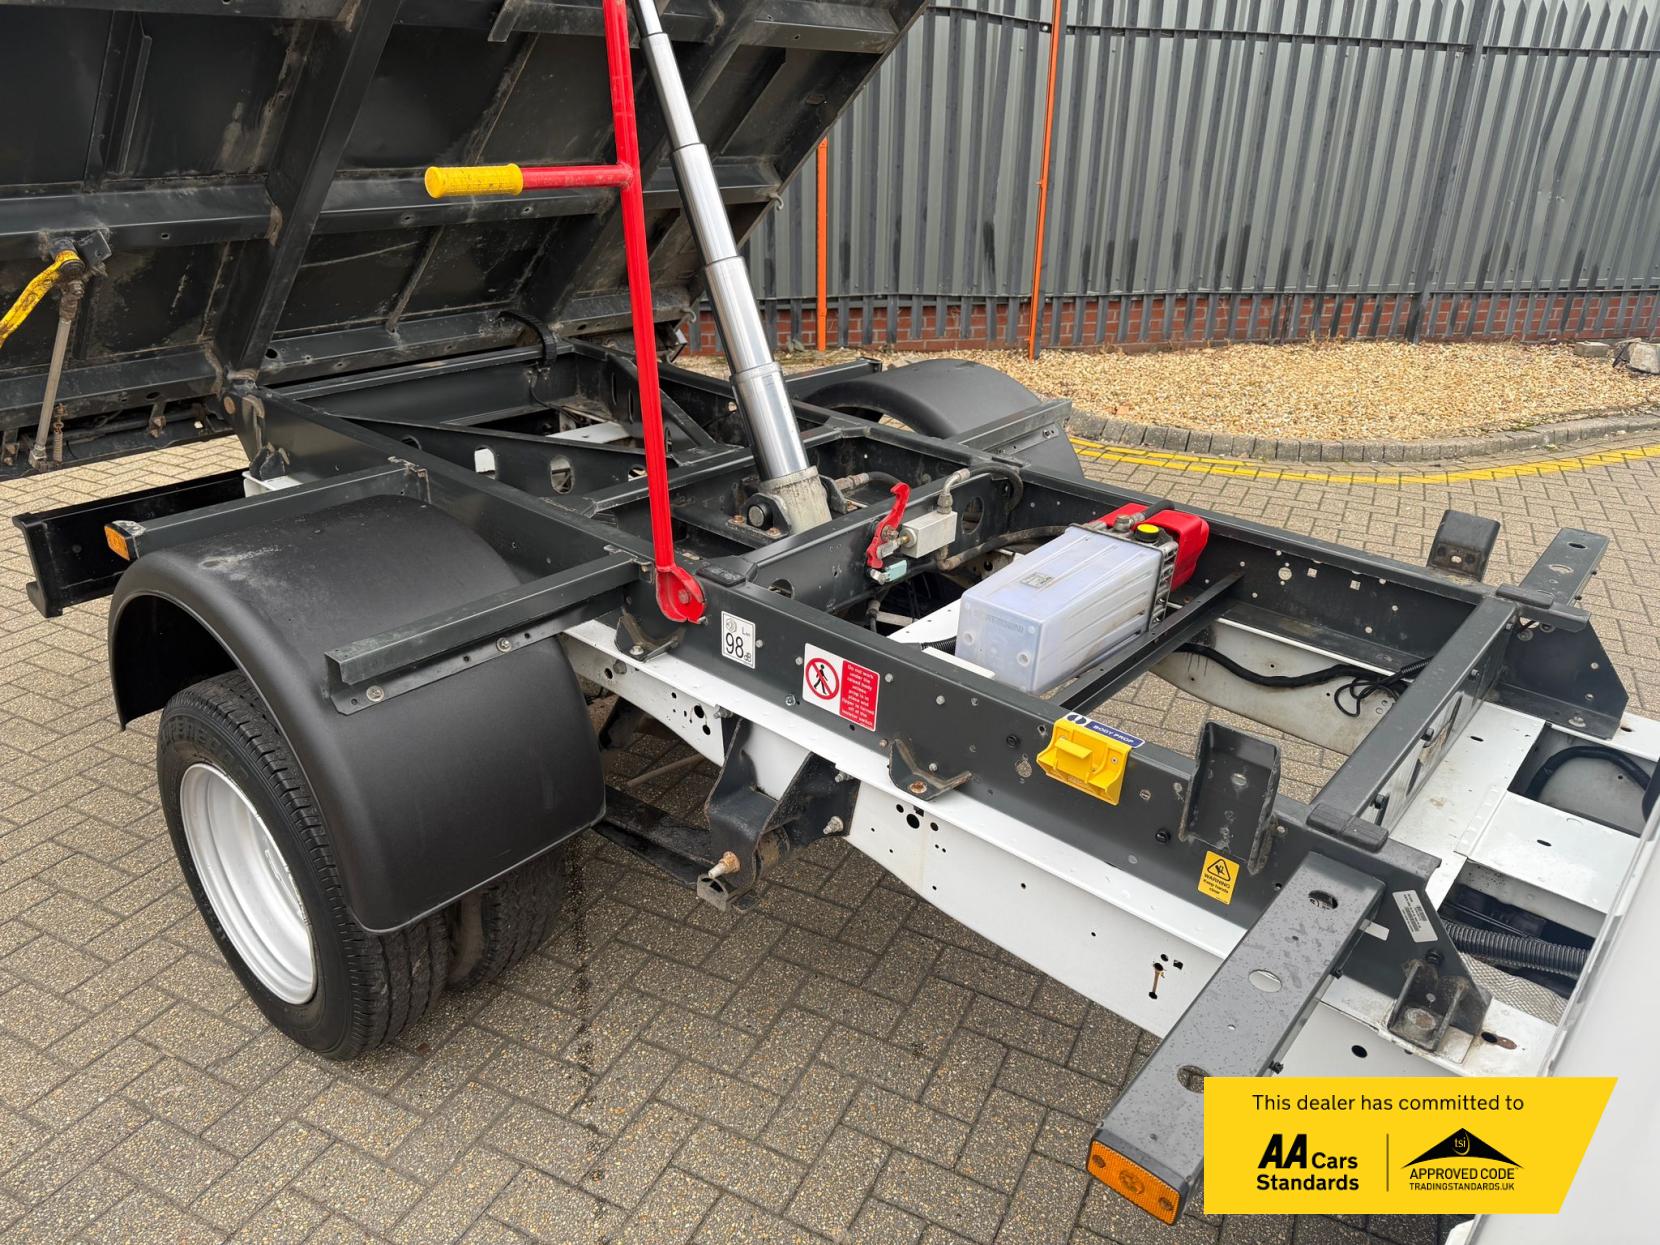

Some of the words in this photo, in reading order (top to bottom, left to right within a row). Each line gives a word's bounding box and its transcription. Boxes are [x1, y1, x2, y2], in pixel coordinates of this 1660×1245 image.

[725, 632, 744, 658] 98
[744, 652, 752, 662] dB
[862, 671, 874, 680] work
[1092, 725, 1114, 735] BODY
[1113, 733, 1134, 743] PROP
[1203, 879, 1215, 887] Keep
[1215, 884, 1229, 893] hands
[1204, 873, 1231, 888] WARNING
